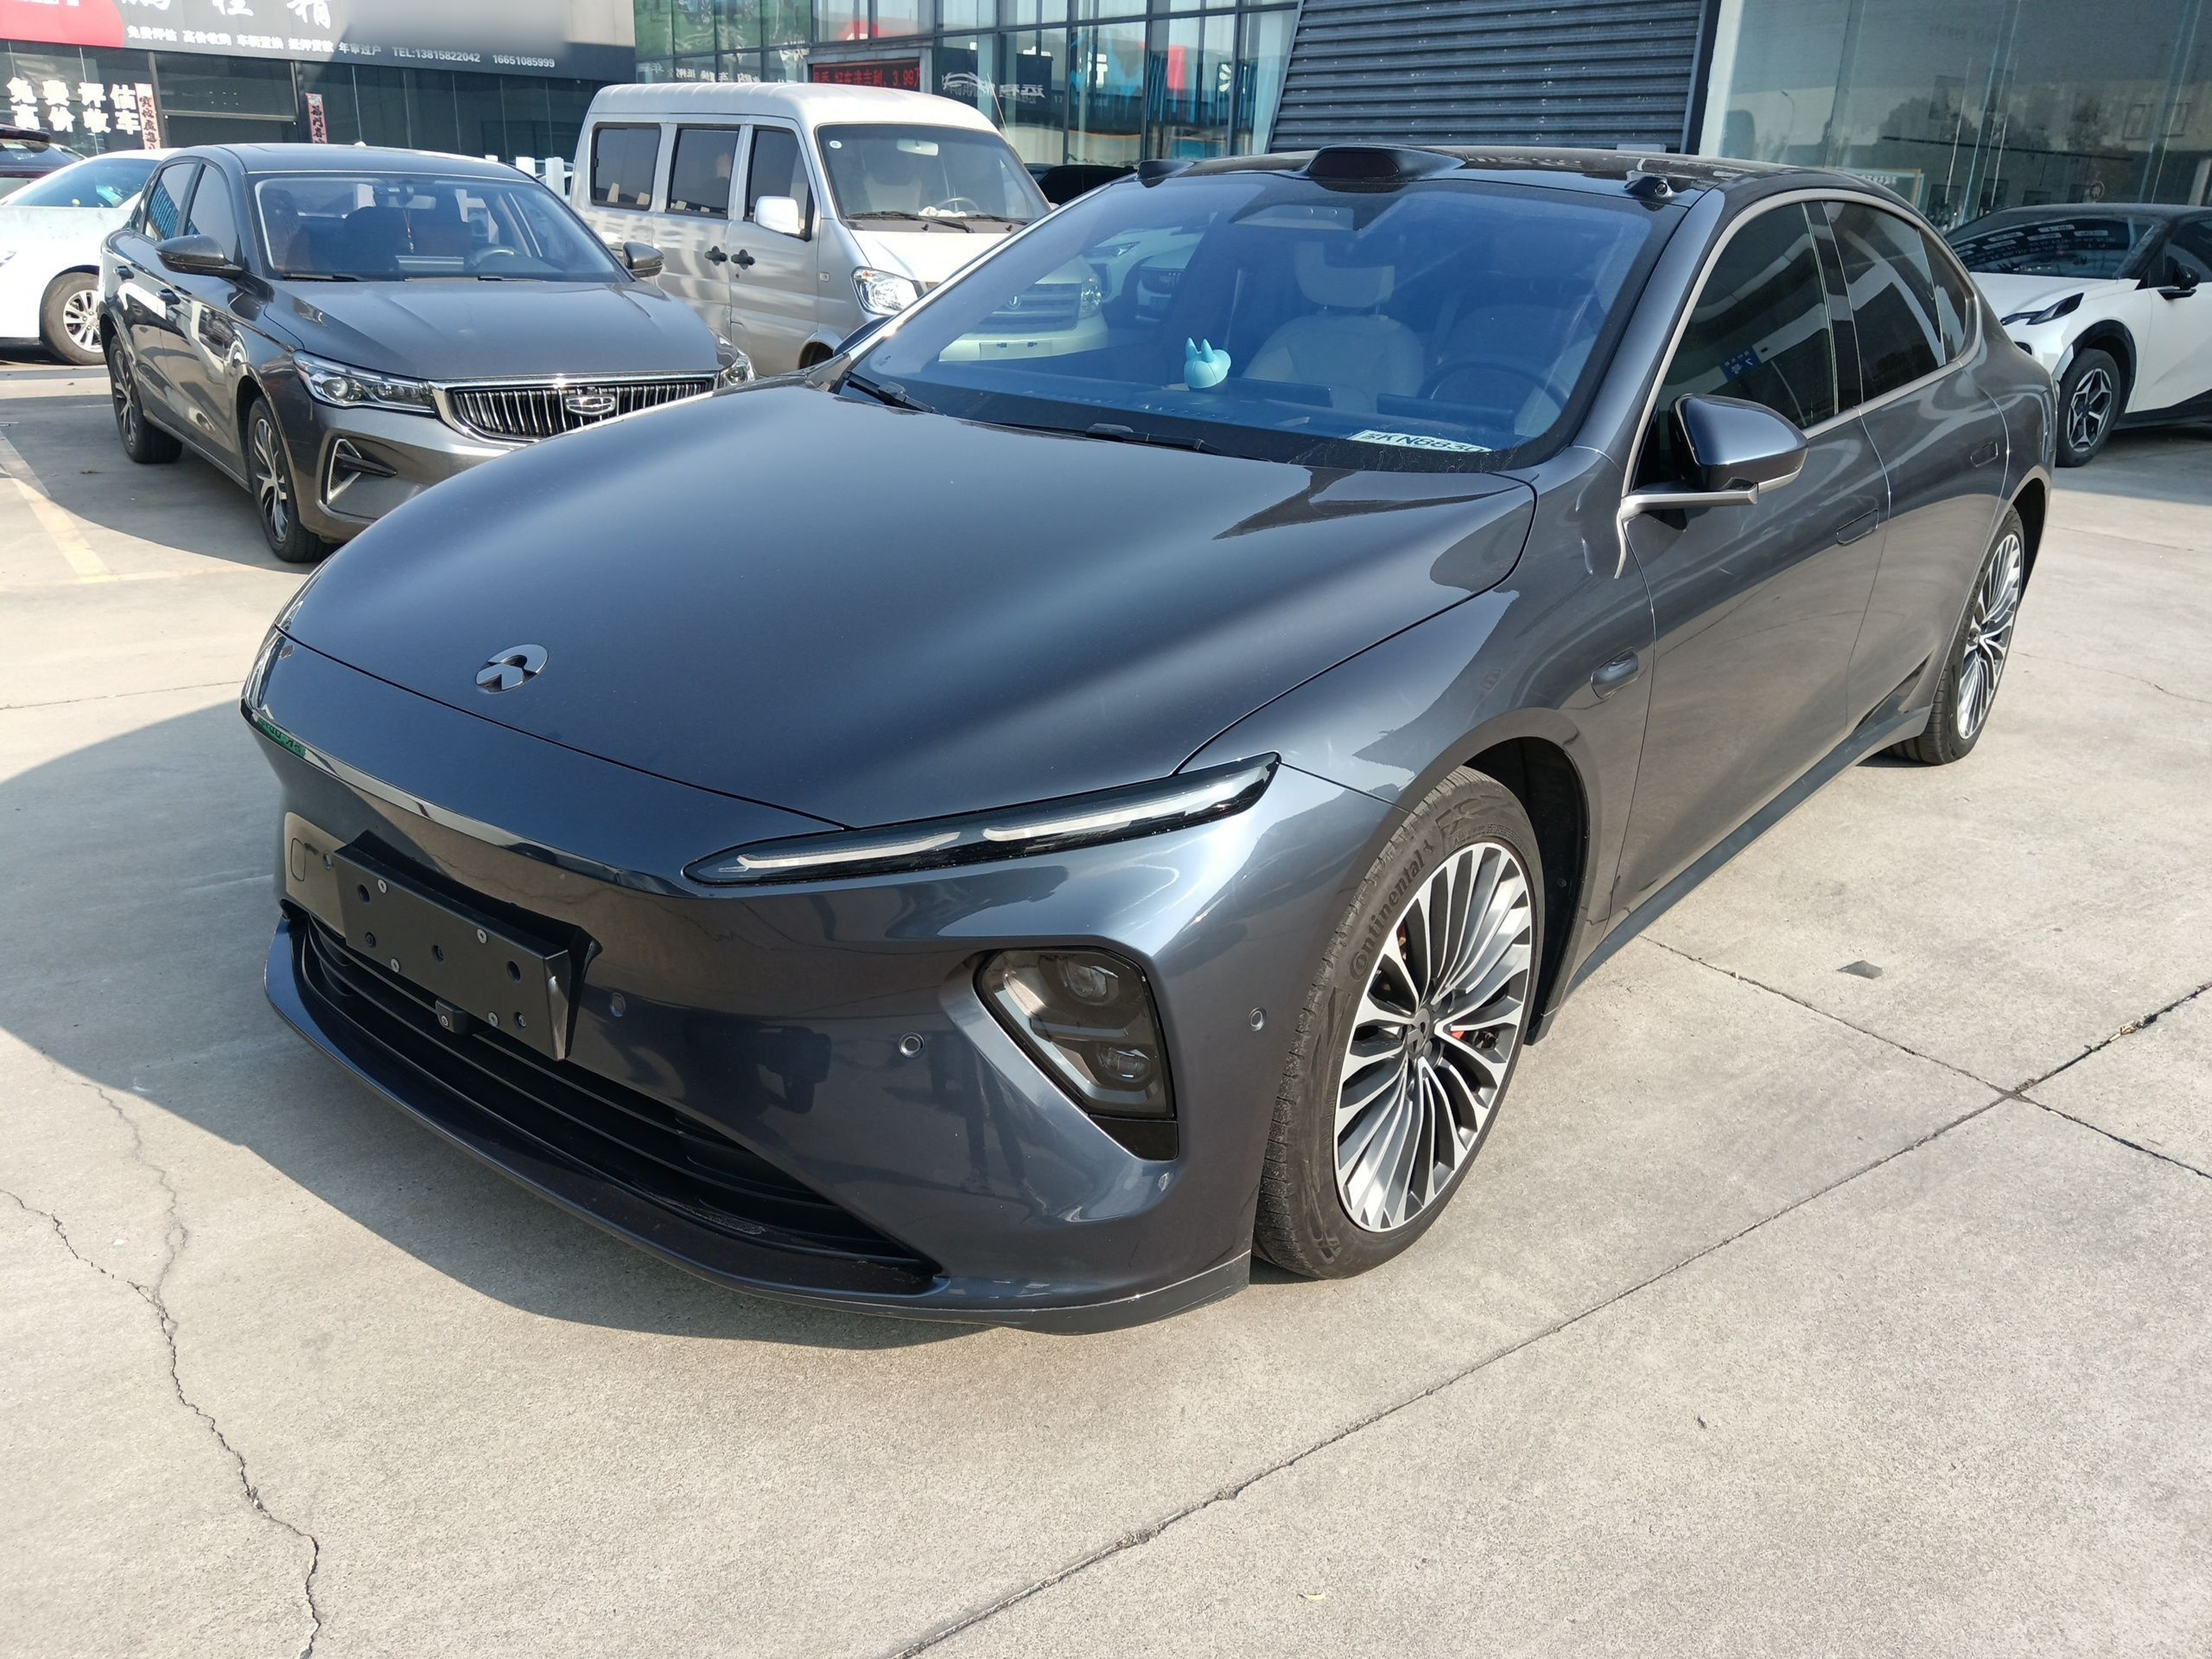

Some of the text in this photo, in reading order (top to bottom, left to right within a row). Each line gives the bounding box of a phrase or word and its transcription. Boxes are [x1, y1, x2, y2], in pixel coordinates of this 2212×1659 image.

[339, 41, 381, 56] 年审过户
[493, 54, 555, 68] 16651085999
[6, 77, 137, 110] 免费评估
[11, 104, 141, 135] 高价收车
[1350, 849, 1425, 981] Continental
